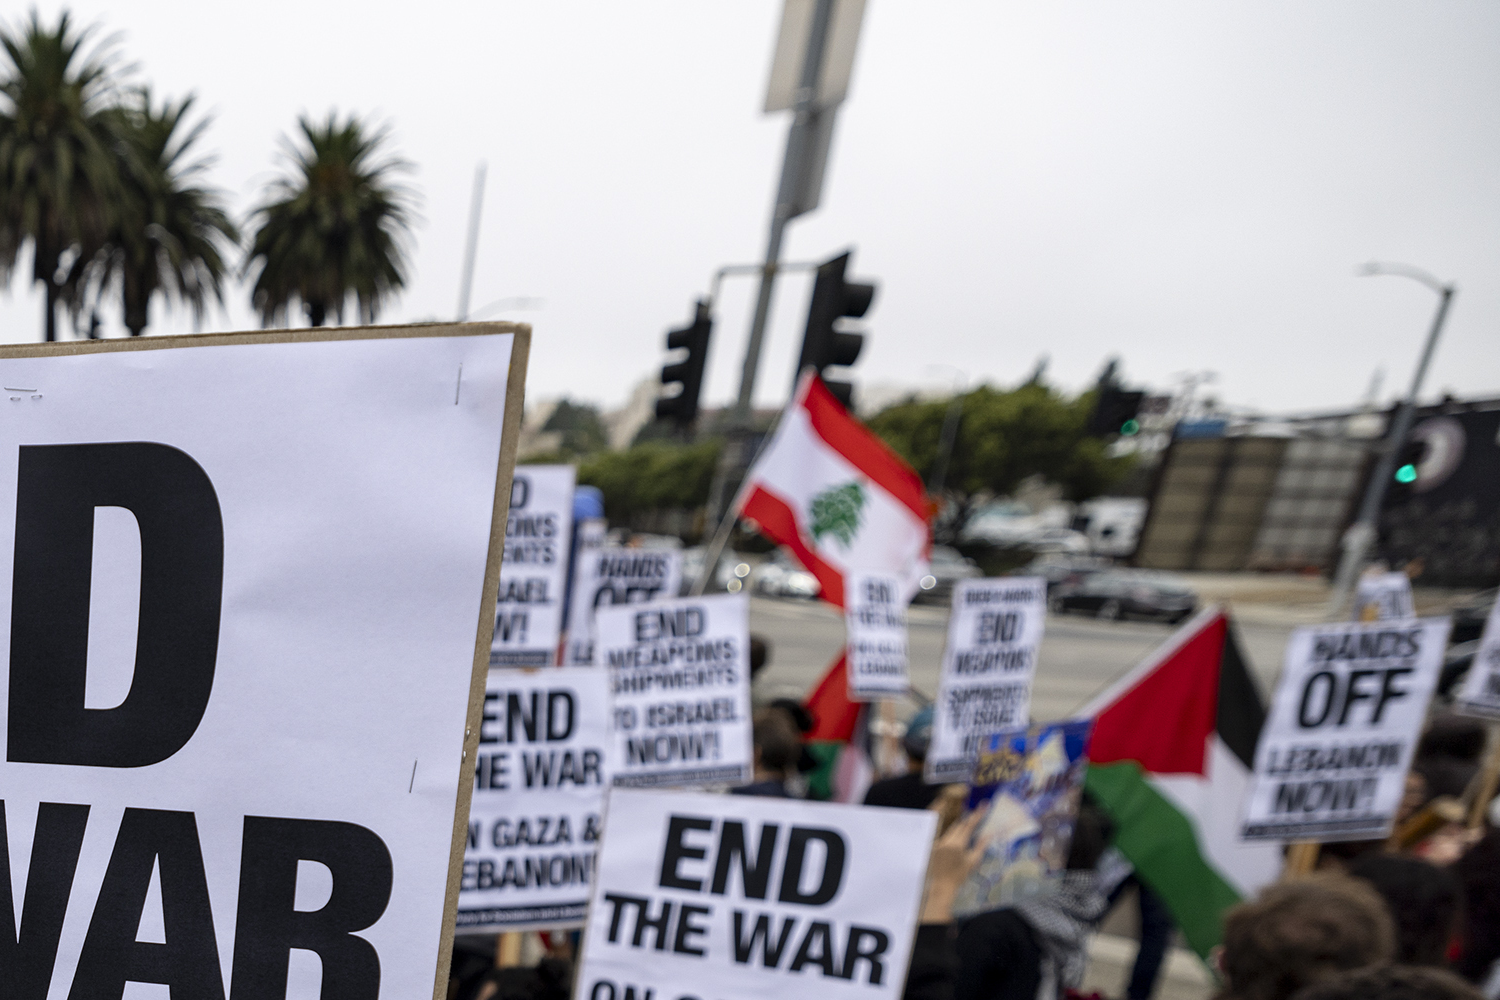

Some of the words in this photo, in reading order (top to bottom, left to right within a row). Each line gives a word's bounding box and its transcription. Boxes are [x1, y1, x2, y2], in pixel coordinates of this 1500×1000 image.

[636, 607, 708, 642] END
[1311, 629, 1423, 661] HANDS
[1298, 668, 1414, 729] OFF
[522, 750, 604, 788] WAR
[466, 823, 481, 850] N
[492, 817, 573, 849] GAZA
[658, 815, 846, 906] END
[603, 893, 713, 957] THE
[731, 910, 890, 985] WAR
